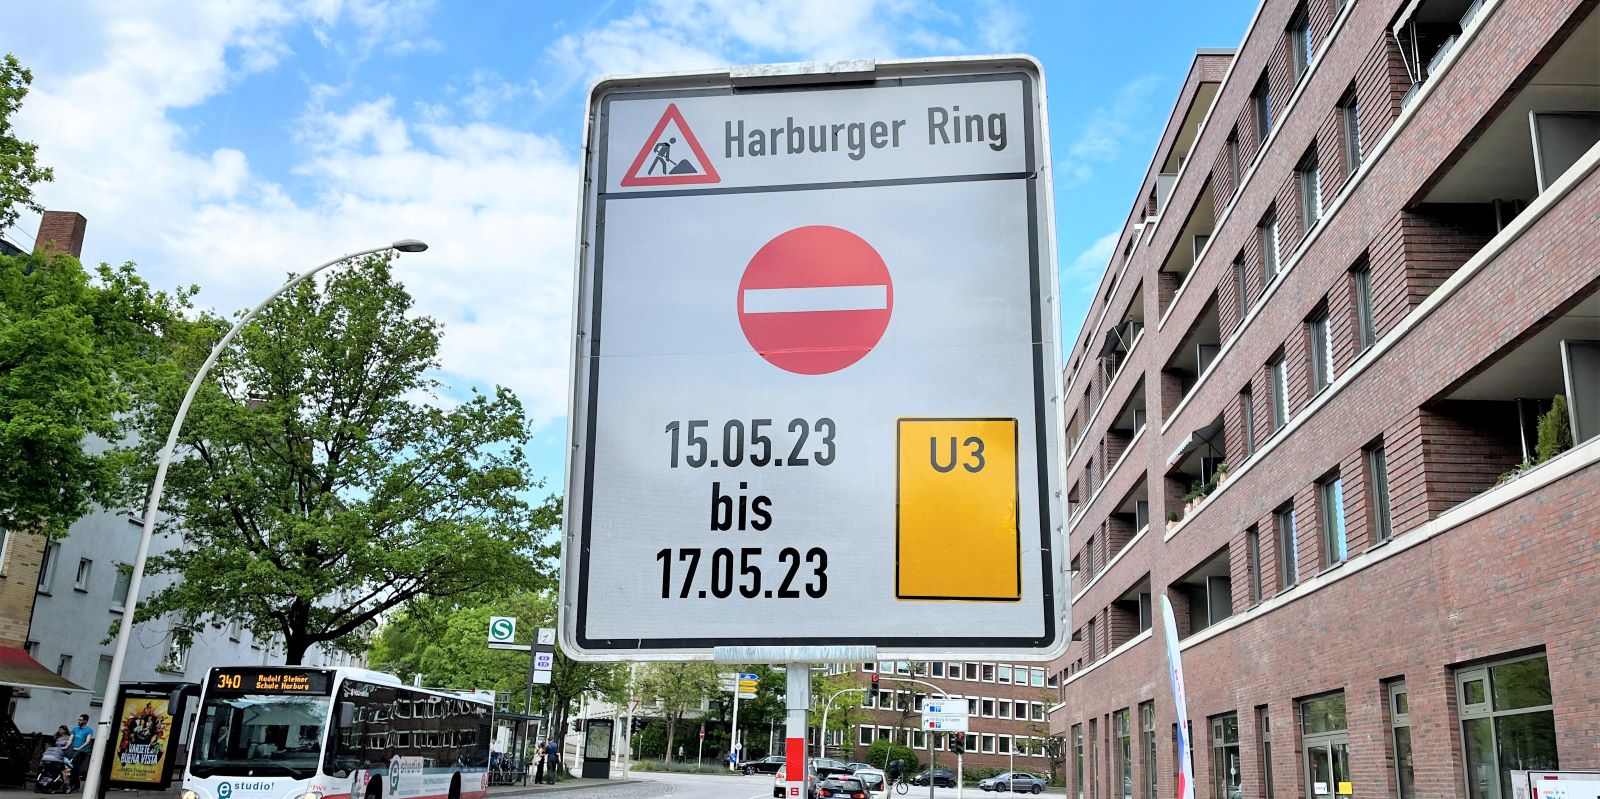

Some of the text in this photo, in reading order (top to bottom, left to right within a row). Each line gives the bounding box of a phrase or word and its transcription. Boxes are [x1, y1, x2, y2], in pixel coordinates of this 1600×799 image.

[724, 107, 1007, 161] Harburger Ring
[664, 418, 837, 469] 15.05.23
[929, 436, 987, 474] U3
[710, 481, 773, 532] bis
[655, 547, 829, 600] 17.05.23
[217, 674, 242, 689] 340
[255, 681, 310, 690] Schule Harburg
[258, 674, 309, 683] Rudolf Steiner
[140, 754, 158, 765] VISTA
[234, 782, 275, 790] studio!
